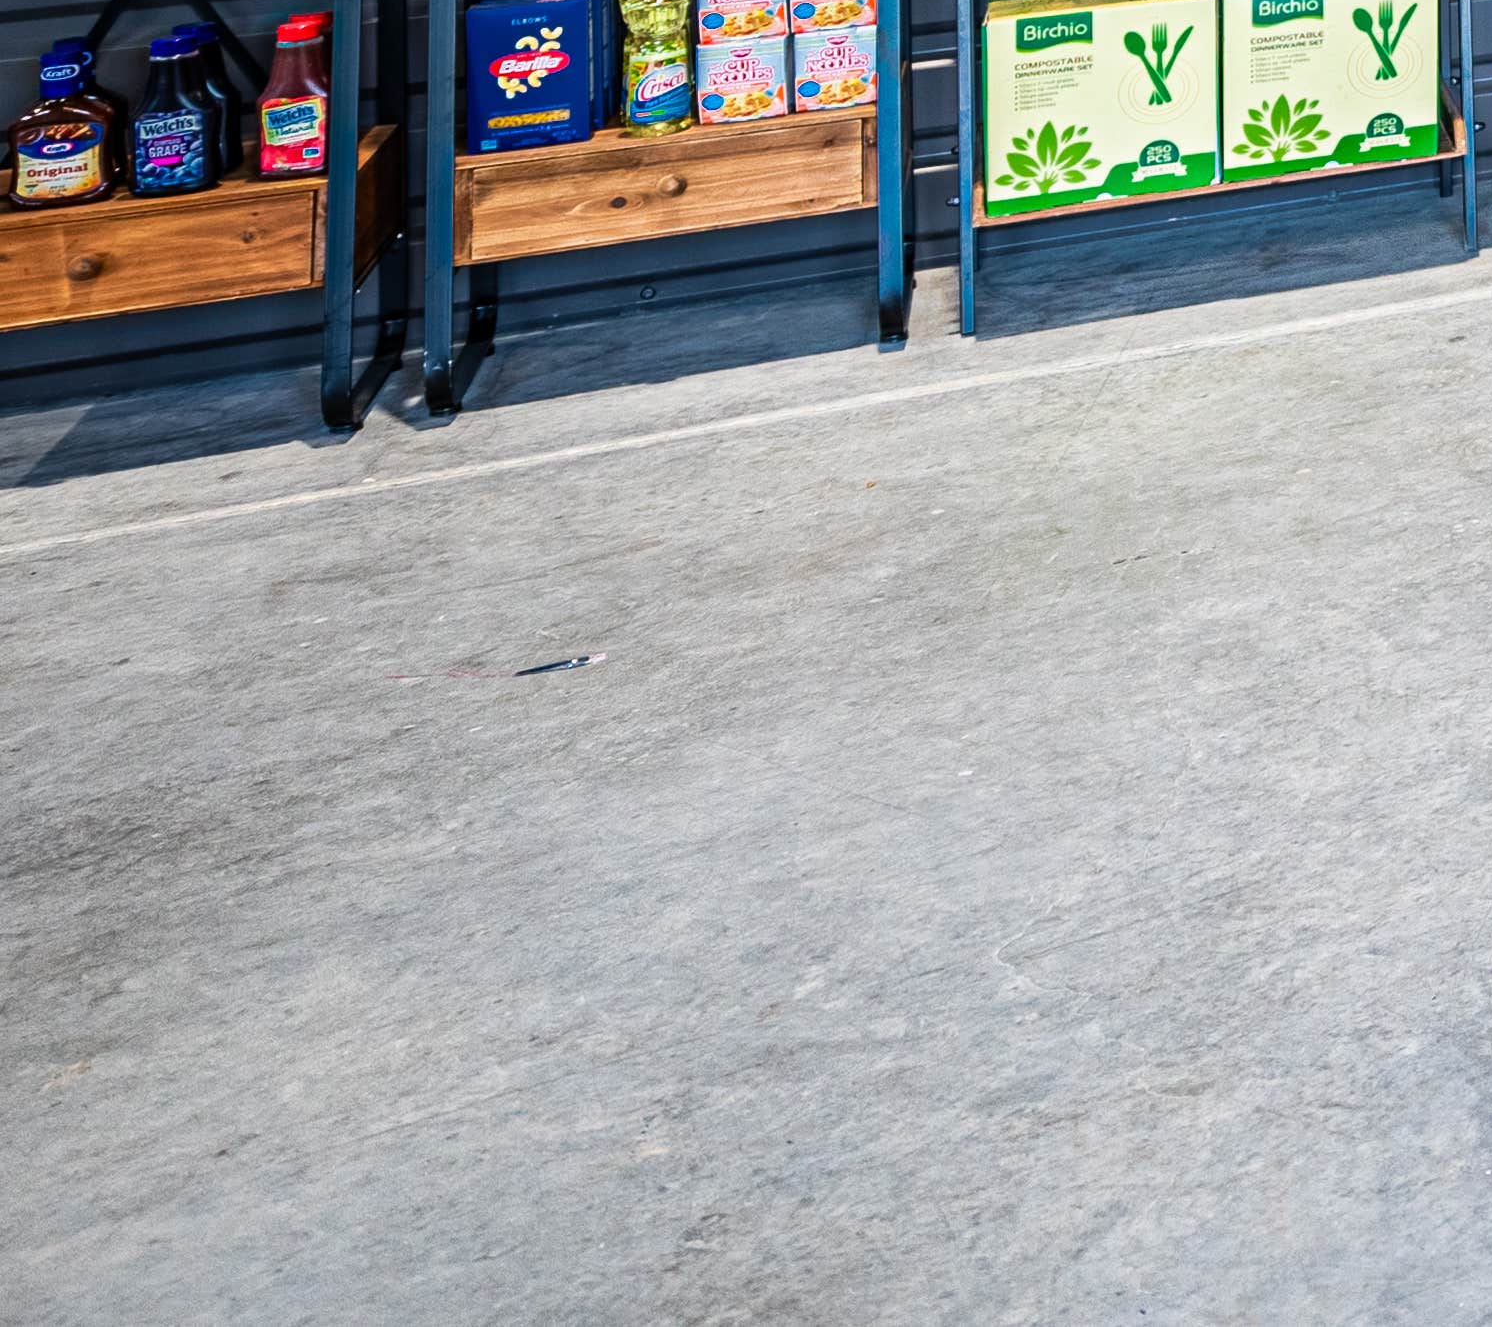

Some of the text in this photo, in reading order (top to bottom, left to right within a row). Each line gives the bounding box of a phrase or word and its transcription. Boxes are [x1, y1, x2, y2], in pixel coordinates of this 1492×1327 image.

[1023, 22, 1088, 41] Birchio
[1250, 31, 1324, 44] COMPOSTABLE
[1251, 38, 1324, 52] DINNERWARE SET
[499, 55, 563, 74] Barilla
[1014, 55, 1094, 71] COMPOSTABLE
[1015, 64, 1094, 79] DINNERWARE SET
[640, 71, 684, 101] Crisco
[142, 116, 194, 137] Welch's
[1374, 118, 1397, 126] 250
[1373, 126, 1396, 135] PCS
[149, 142, 188, 158] GRAPE
[1147, 144, 1171, 154] 250
[1146, 154, 1172, 164] PCS
[27, 162, 89, 178] Original
